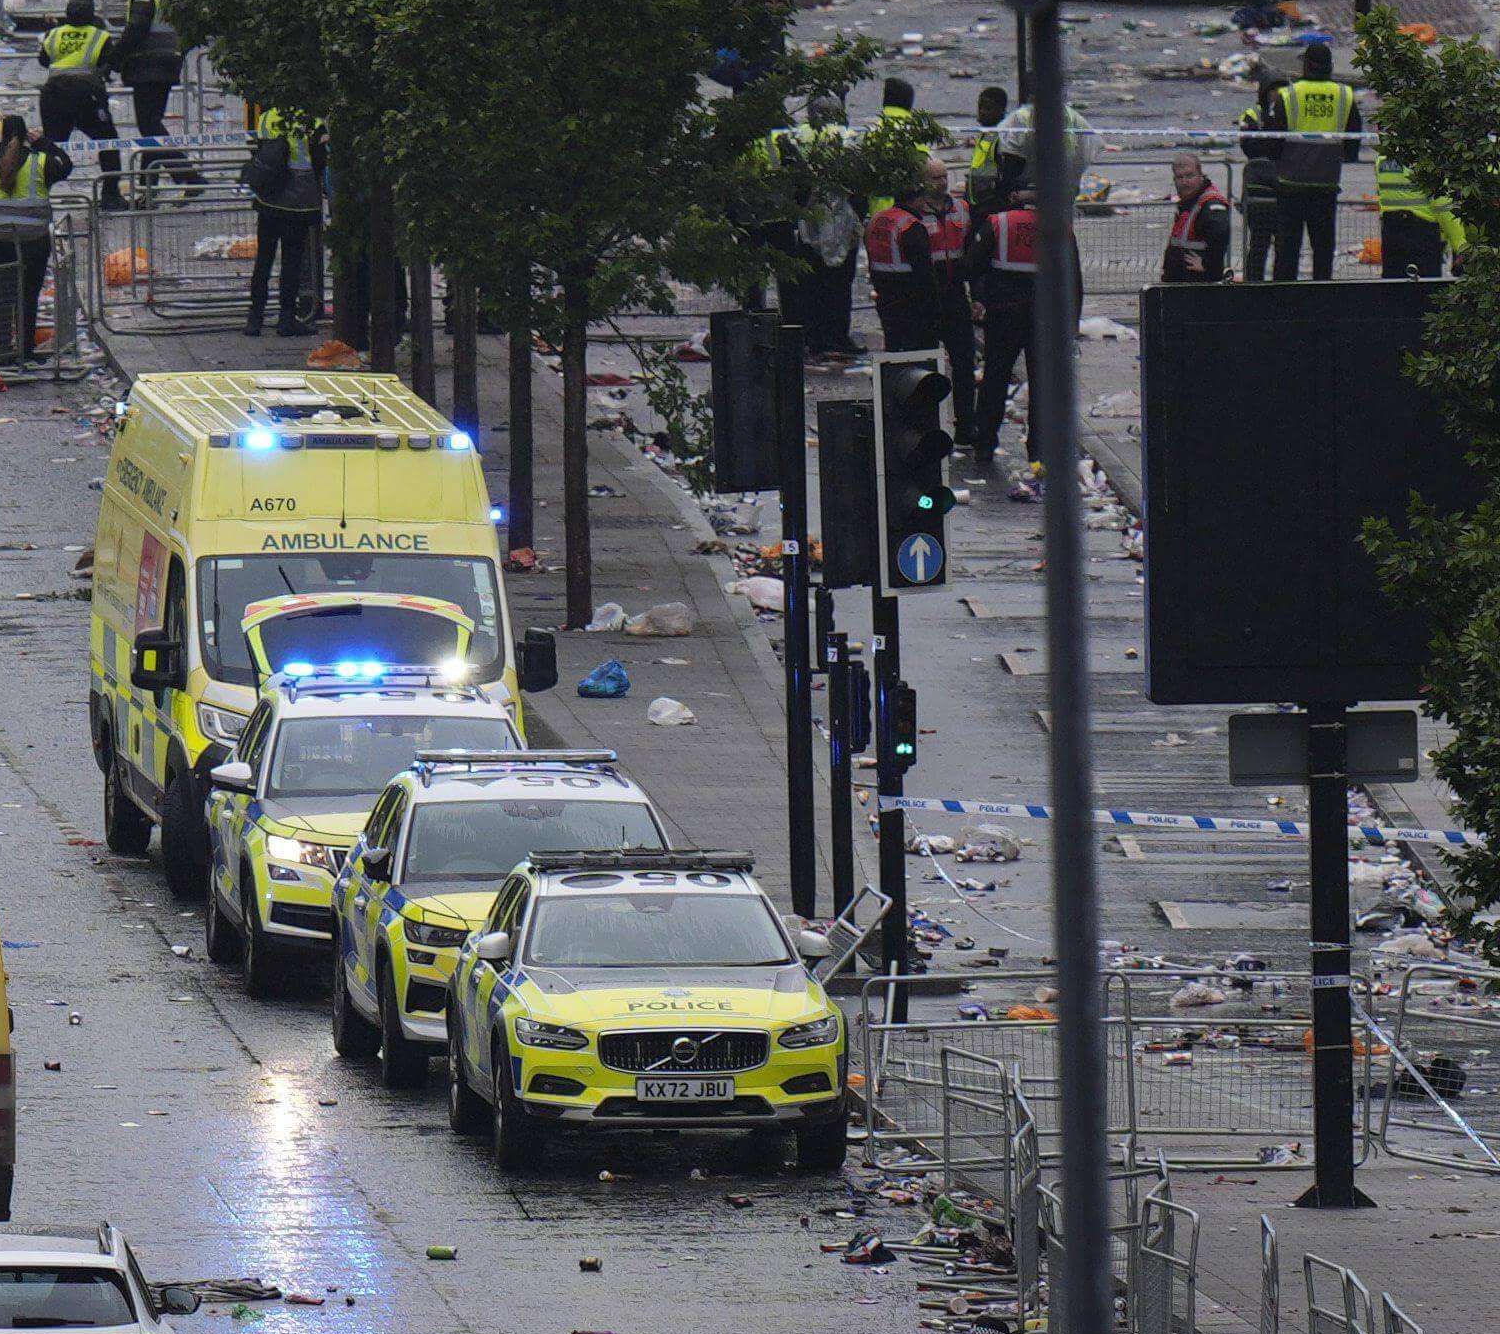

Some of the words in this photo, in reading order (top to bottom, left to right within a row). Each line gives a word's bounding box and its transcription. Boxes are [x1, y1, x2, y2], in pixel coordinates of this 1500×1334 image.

[250, 496, 297, 512] A670
[261, 533, 430, 552] AMBULANCE
[895, 799, 926, 809] POLICE
[979, 804, 1010, 814] POLICE
[1147, 815, 1179, 826] POLICE
[1230, 820, 1262, 831] POLICE
[1398, 830, 1430, 839] POLICE
[628, 1001, 733, 1012] POLICE
[644, 1082, 688, 1098] KX72
[694, 1082, 727, 1098] JBU
